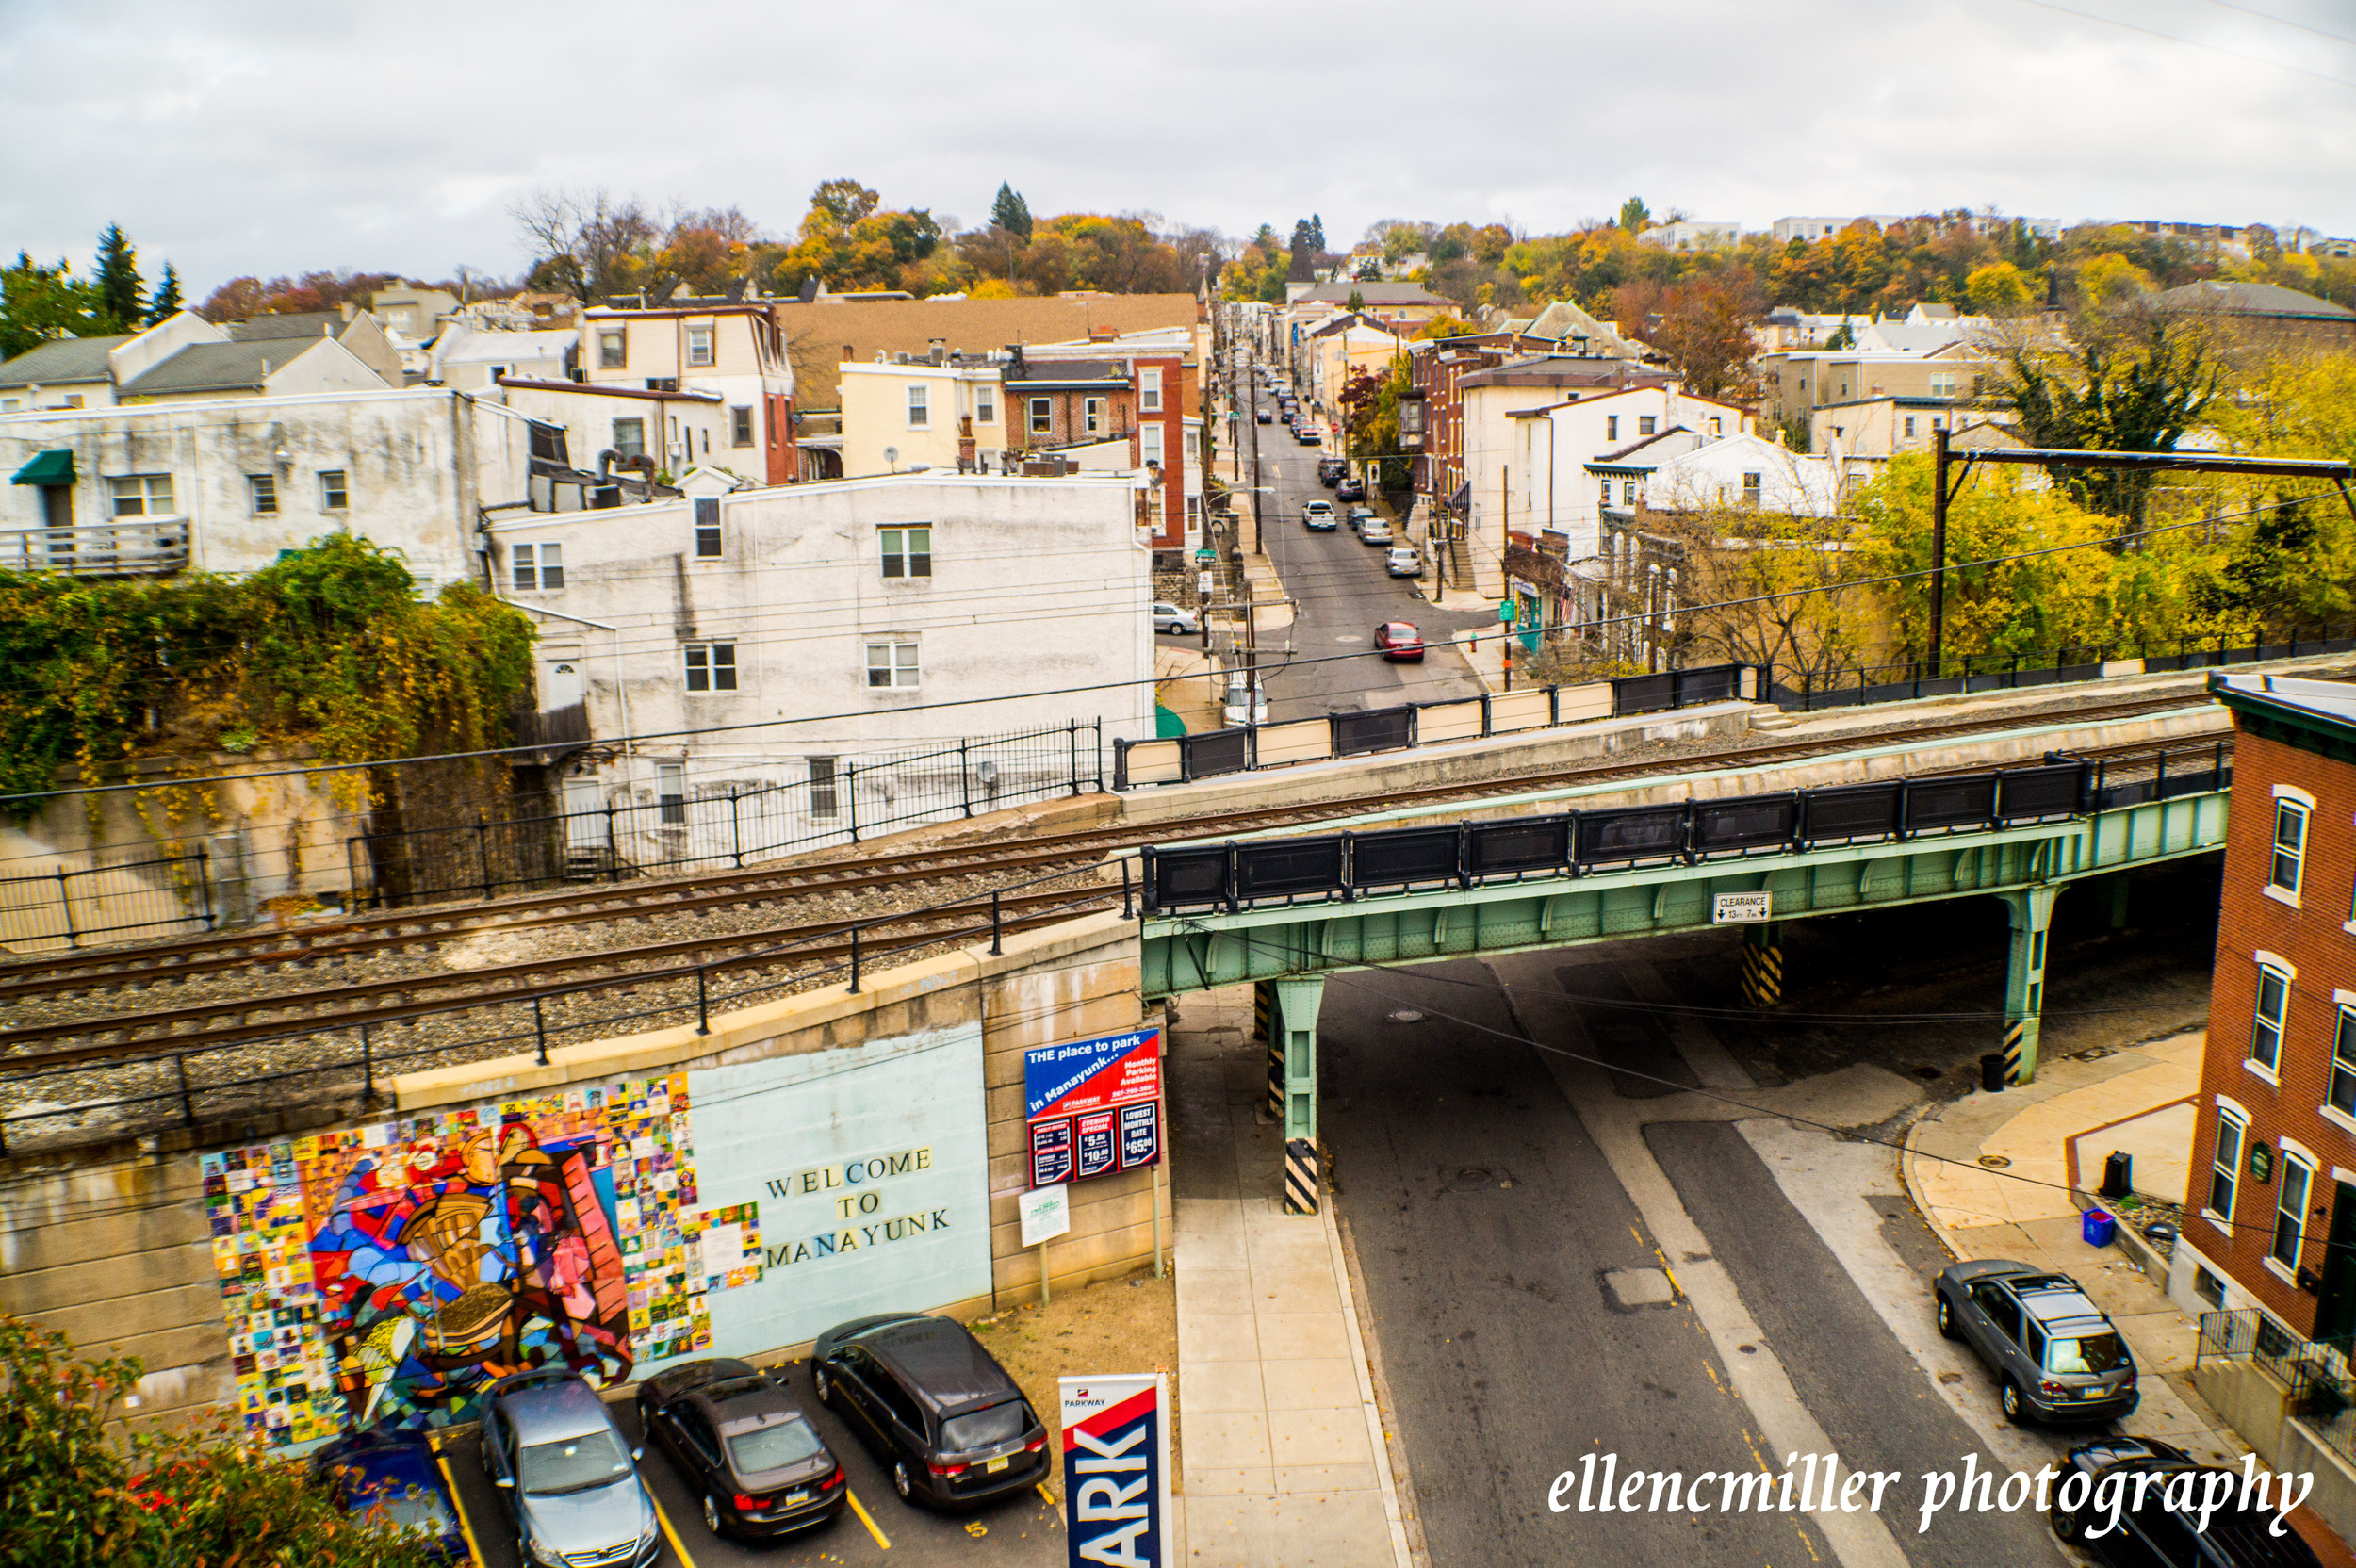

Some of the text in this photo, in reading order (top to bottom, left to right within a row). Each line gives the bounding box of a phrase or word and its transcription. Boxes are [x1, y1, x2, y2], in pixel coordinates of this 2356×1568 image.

[1720, 896, 1766, 906] CLEARANCE
[1028, 1035, 1140, 1063] THE place to park
[1124, 1057, 1156, 1069] Monthly
[1126, 1066, 1156, 1077] Parking
[1029, 1053, 1119, 1112] in Manayunk...
[1121, 1073, 1156, 1086] Available
[1072, 1095, 1101, 1106] PARKWAY
[1125, 1107, 1151, 1120] LOWEST
[1081, 1116, 1110, 1127] EVENING
[1124, 1117, 1153, 1130] MONTHLY
[1081, 1123, 1108, 1134] SPECIAL
[1131, 1127, 1147, 1138] RATE
[764, 1149, 931, 1200] WELCOME
[837, 1193, 879, 1218] TO
[764, 1209, 951, 1269] MANAYUNK
[1064, 1398, 1105, 1407] PARKWAY
